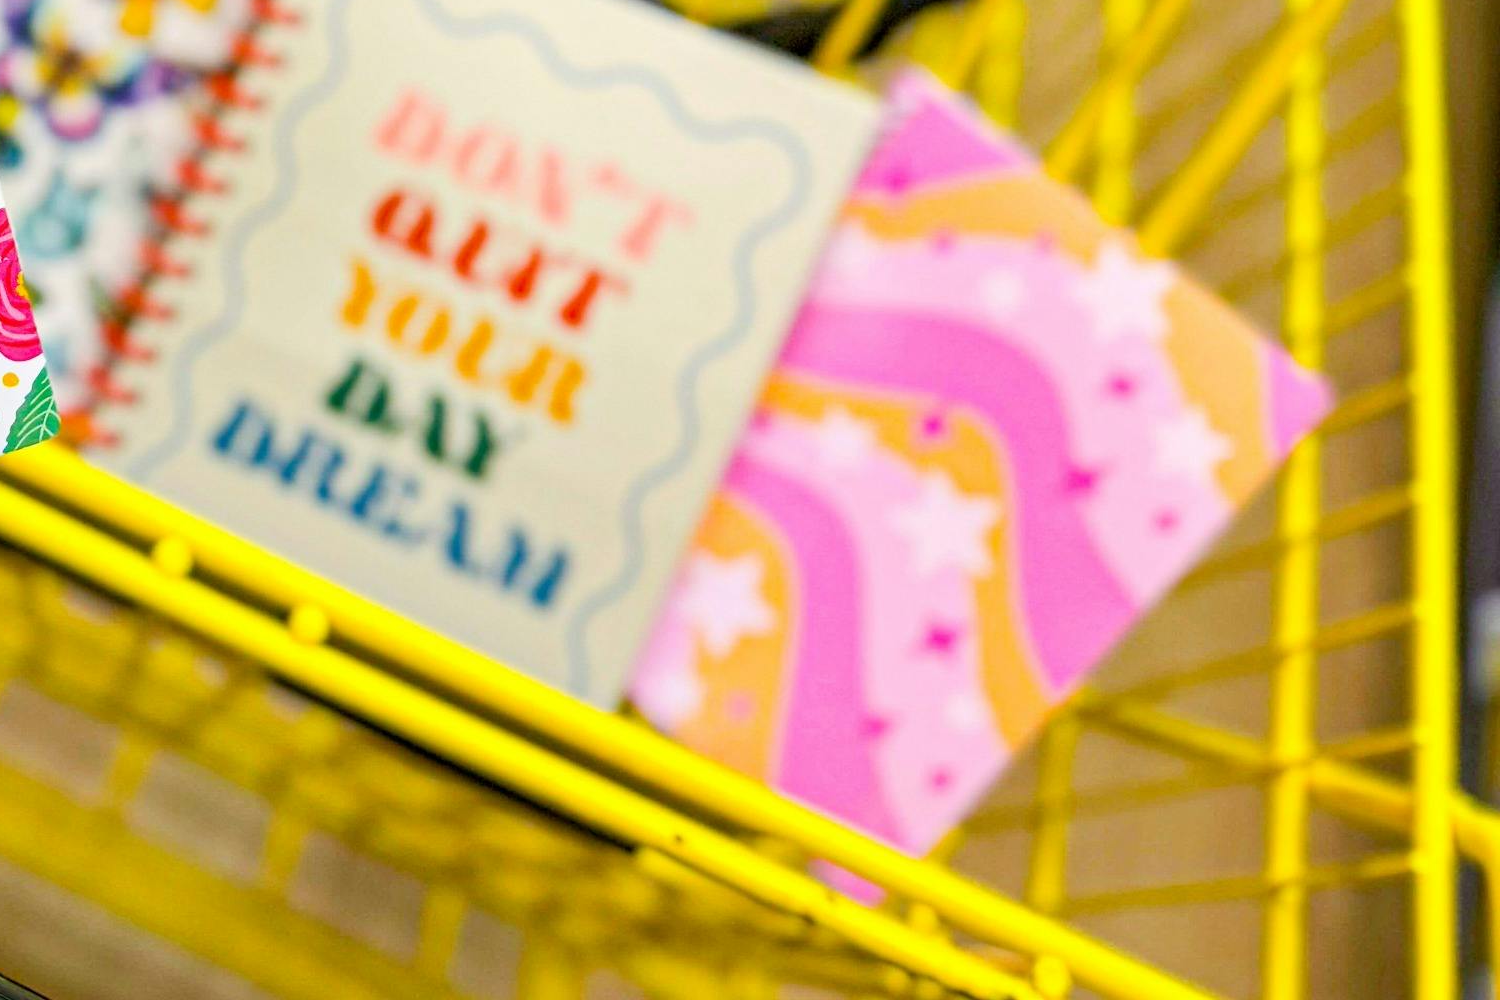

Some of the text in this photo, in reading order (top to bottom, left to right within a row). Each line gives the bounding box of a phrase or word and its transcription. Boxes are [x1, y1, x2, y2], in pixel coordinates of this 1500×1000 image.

[371, 189, 631, 331] QUIT
[325, 356, 525, 481] DAY
[339, 257, 587, 425] YOUR
[209, 400, 570, 608] DREAM
